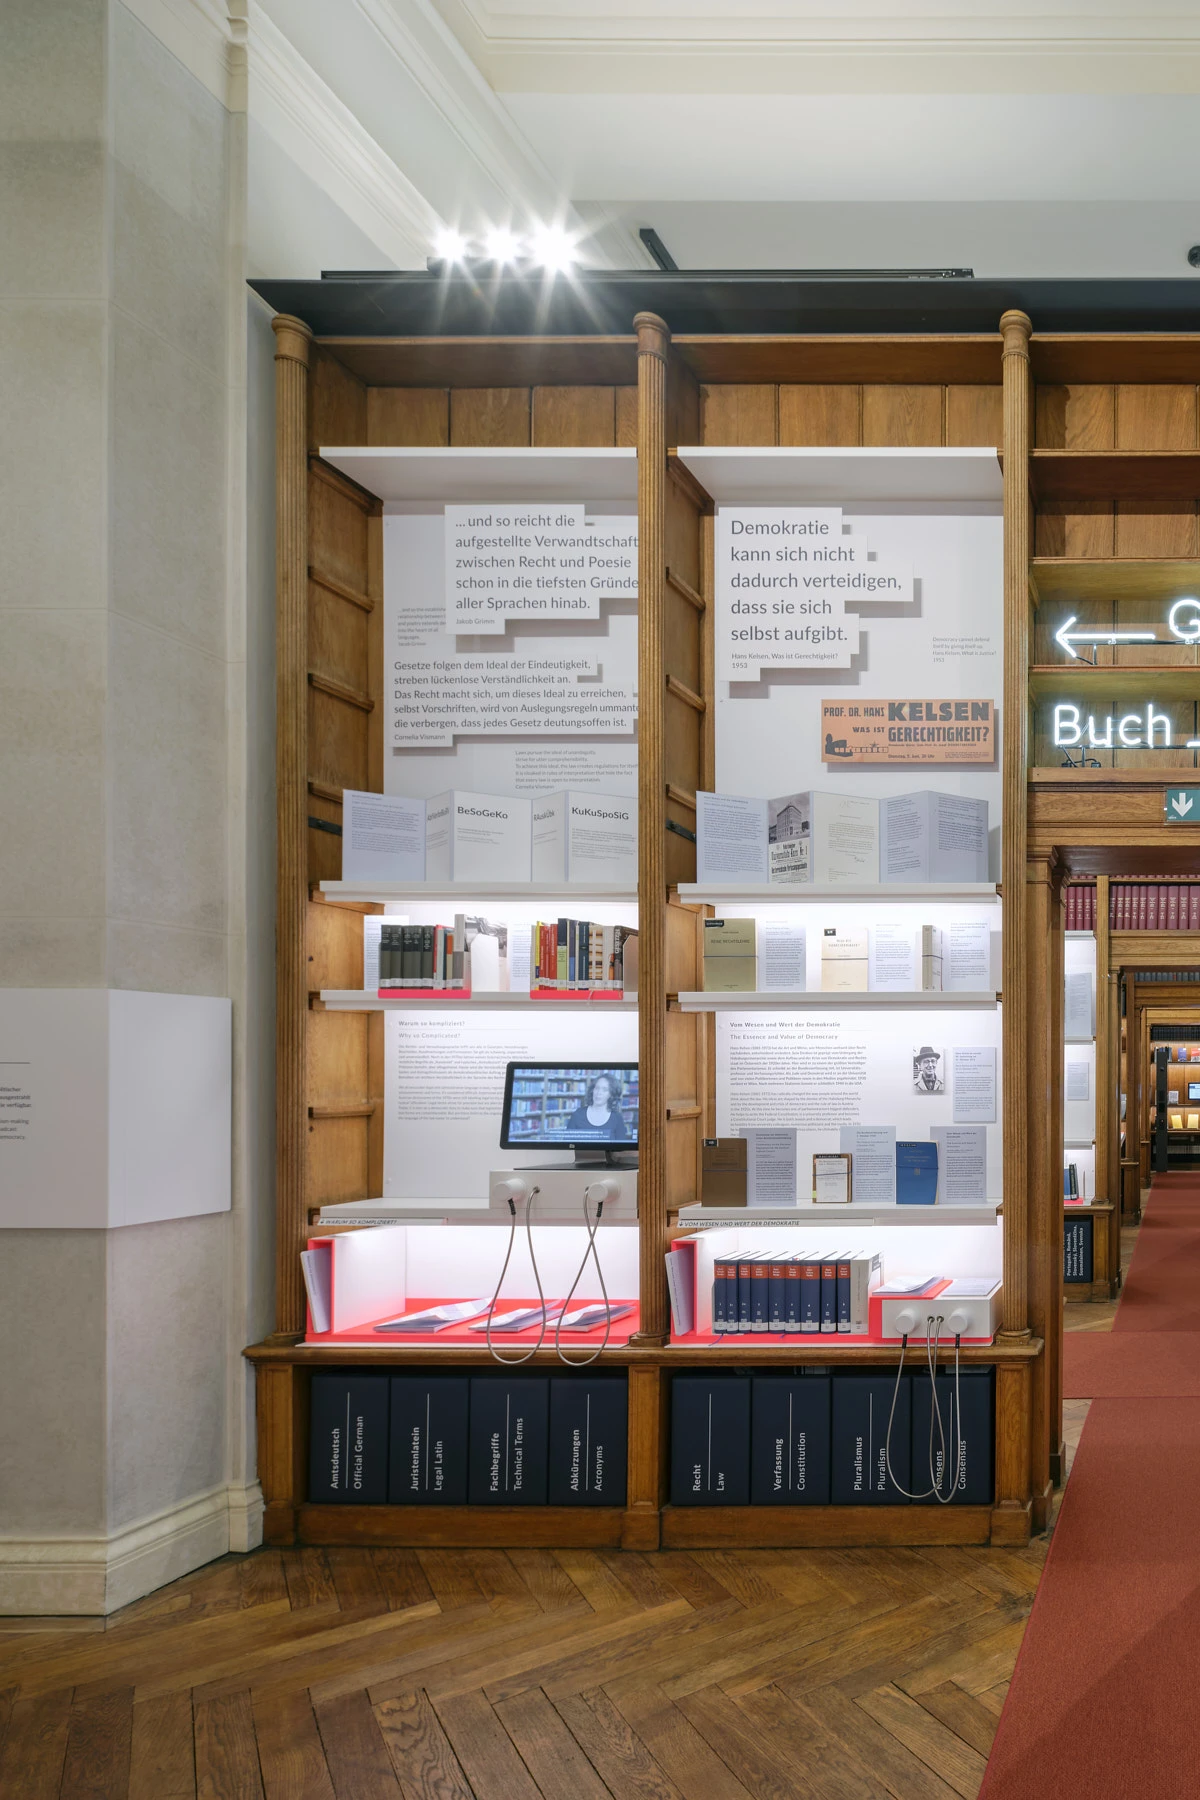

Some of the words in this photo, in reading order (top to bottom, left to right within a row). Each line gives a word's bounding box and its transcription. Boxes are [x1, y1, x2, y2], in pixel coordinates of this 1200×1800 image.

[468, 515, 492, 527] und
[496, 518, 510, 526] so
[515, 514, 551, 526] reicht
[555, 515, 575, 526] die
[732, 520, 829, 535] Demokratie
[456, 535, 531, 550] aufgestellte
[535, 536, 638, 547] Verwandtschaft
[456, 556, 515, 568] zwischen
[520, 556, 556, 567] Recht
[560, 556, 584, 567] und
[589, 556, 631, 568] Poesie
[731, 546, 770, 561] kann
[776, 547, 807, 561] sich
[814, 546, 854, 561] nicht
[456, 576, 493, 588] schon
[498, 577, 509, 588] in
[513, 576, 532, 588] die
[536, 576, 586, 588] tiefsten
[590, 576, 638, 588] Gründe
[731, 573, 797, 588] dadurch
[803, 573, 901, 591] verteidigen,
[456, 597, 484, 609] aller
[487, 597, 547, 611] Sprachen
[551, 597, 590, 608] hinab.
[731, 600, 767, 614] dass
[772, 600, 794, 614] sie
[800, 599, 831, 614] sich
[475, 617, 495, 625] Grimm
[731, 626, 779, 640] selbst
[785, 626, 847, 644] aufgibt.
[394, 661, 431, 670] Gesetze
[433, 661, 461, 671] folgen
[464, 661, 483, 670] dem
[487, 660, 508, 669] Ideal
[511, 660, 526, 669] der
[528, 660, 590, 670] Eindeutigkeit,
[731, 652, 747, 660] Hans
[748, 652, 771, 661] Kelsen,
[771, 652, 785, 660] Was
[786, 652, 794, 660] ist
[794, 652, 838, 662] Gerechtigkeit?
[823, 707, 846, 717] PROF.
[848, 707, 861, 717] DR.
[863, 707, 885, 717] HANS
[888, 702, 990, 722] KELSEN
[888, 726, 990, 742] GERECHTIGKEIT?
[1053, 703, 1171, 746] Buch
[458, 806, 508, 819] BeSoGeKo
[571, 805, 631, 821] KuKuSpoSiG
[354, 1417, 364, 1453] German
[514, 1418, 524, 1446] Terms
[330, 1429, 340, 1489] Amtsdeutsch
[410, 1427, 420, 1491] Juristenlatein
[434, 1441, 443, 1464] Latin
[489, 1433, 501, 1492] Fachbegriffe
[570, 1430, 582, 1491] Abkürzungen
[796, 1433, 806, 1491] Constitution
[353, 1455, 363, 1490] Official
[513, 1448, 523, 1491] Technical
[593, 1446, 605, 1492] Acronyms
[773, 1439, 784, 1491] Verfassung
[853, 1437, 863, 1491] Pluralismus
[877, 1447, 887, 1491] Pluralism
[957, 1440, 968, 1491] Consensus
[433, 1467, 444, 1491] Legal
[692, 1465, 702, 1491] Recht
[715, 1473, 725, 1491] Law
